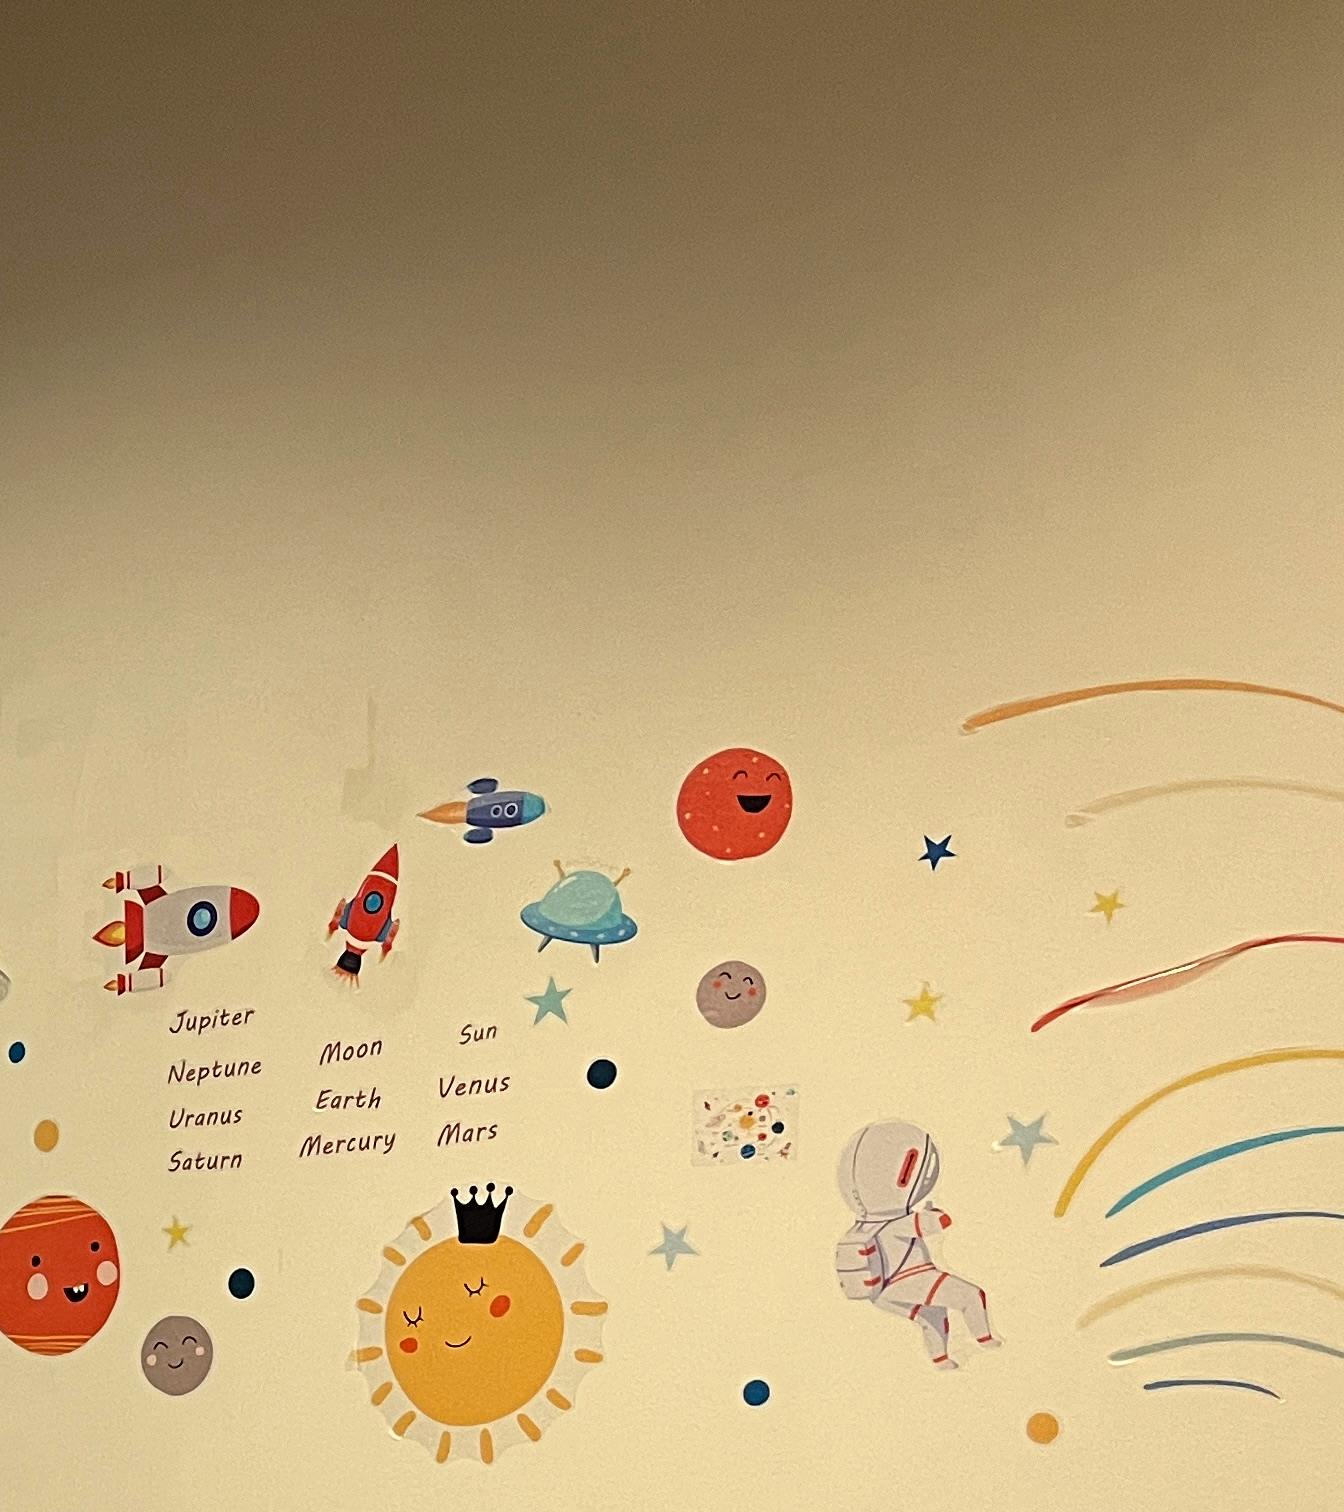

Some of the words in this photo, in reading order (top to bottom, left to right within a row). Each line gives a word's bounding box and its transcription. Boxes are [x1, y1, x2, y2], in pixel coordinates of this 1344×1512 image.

[169, 1009, 254, 1035] Jupiter
[459, 1024, 497, 1045] Sun
[320, 1040, 382, 1065] Moon
[168, 1060, 261, 1086] Neptune
[316, 1087, 380, 1109] Earth
[440, 1076, 510, 1098] Venus
[170, 1108, 242, 1128] Uranus
[299, 1133, 395, 1157] Mercury
[437, 1123, 497, 1146] Mars
[168, 1151, 241, 1172] Saturn
